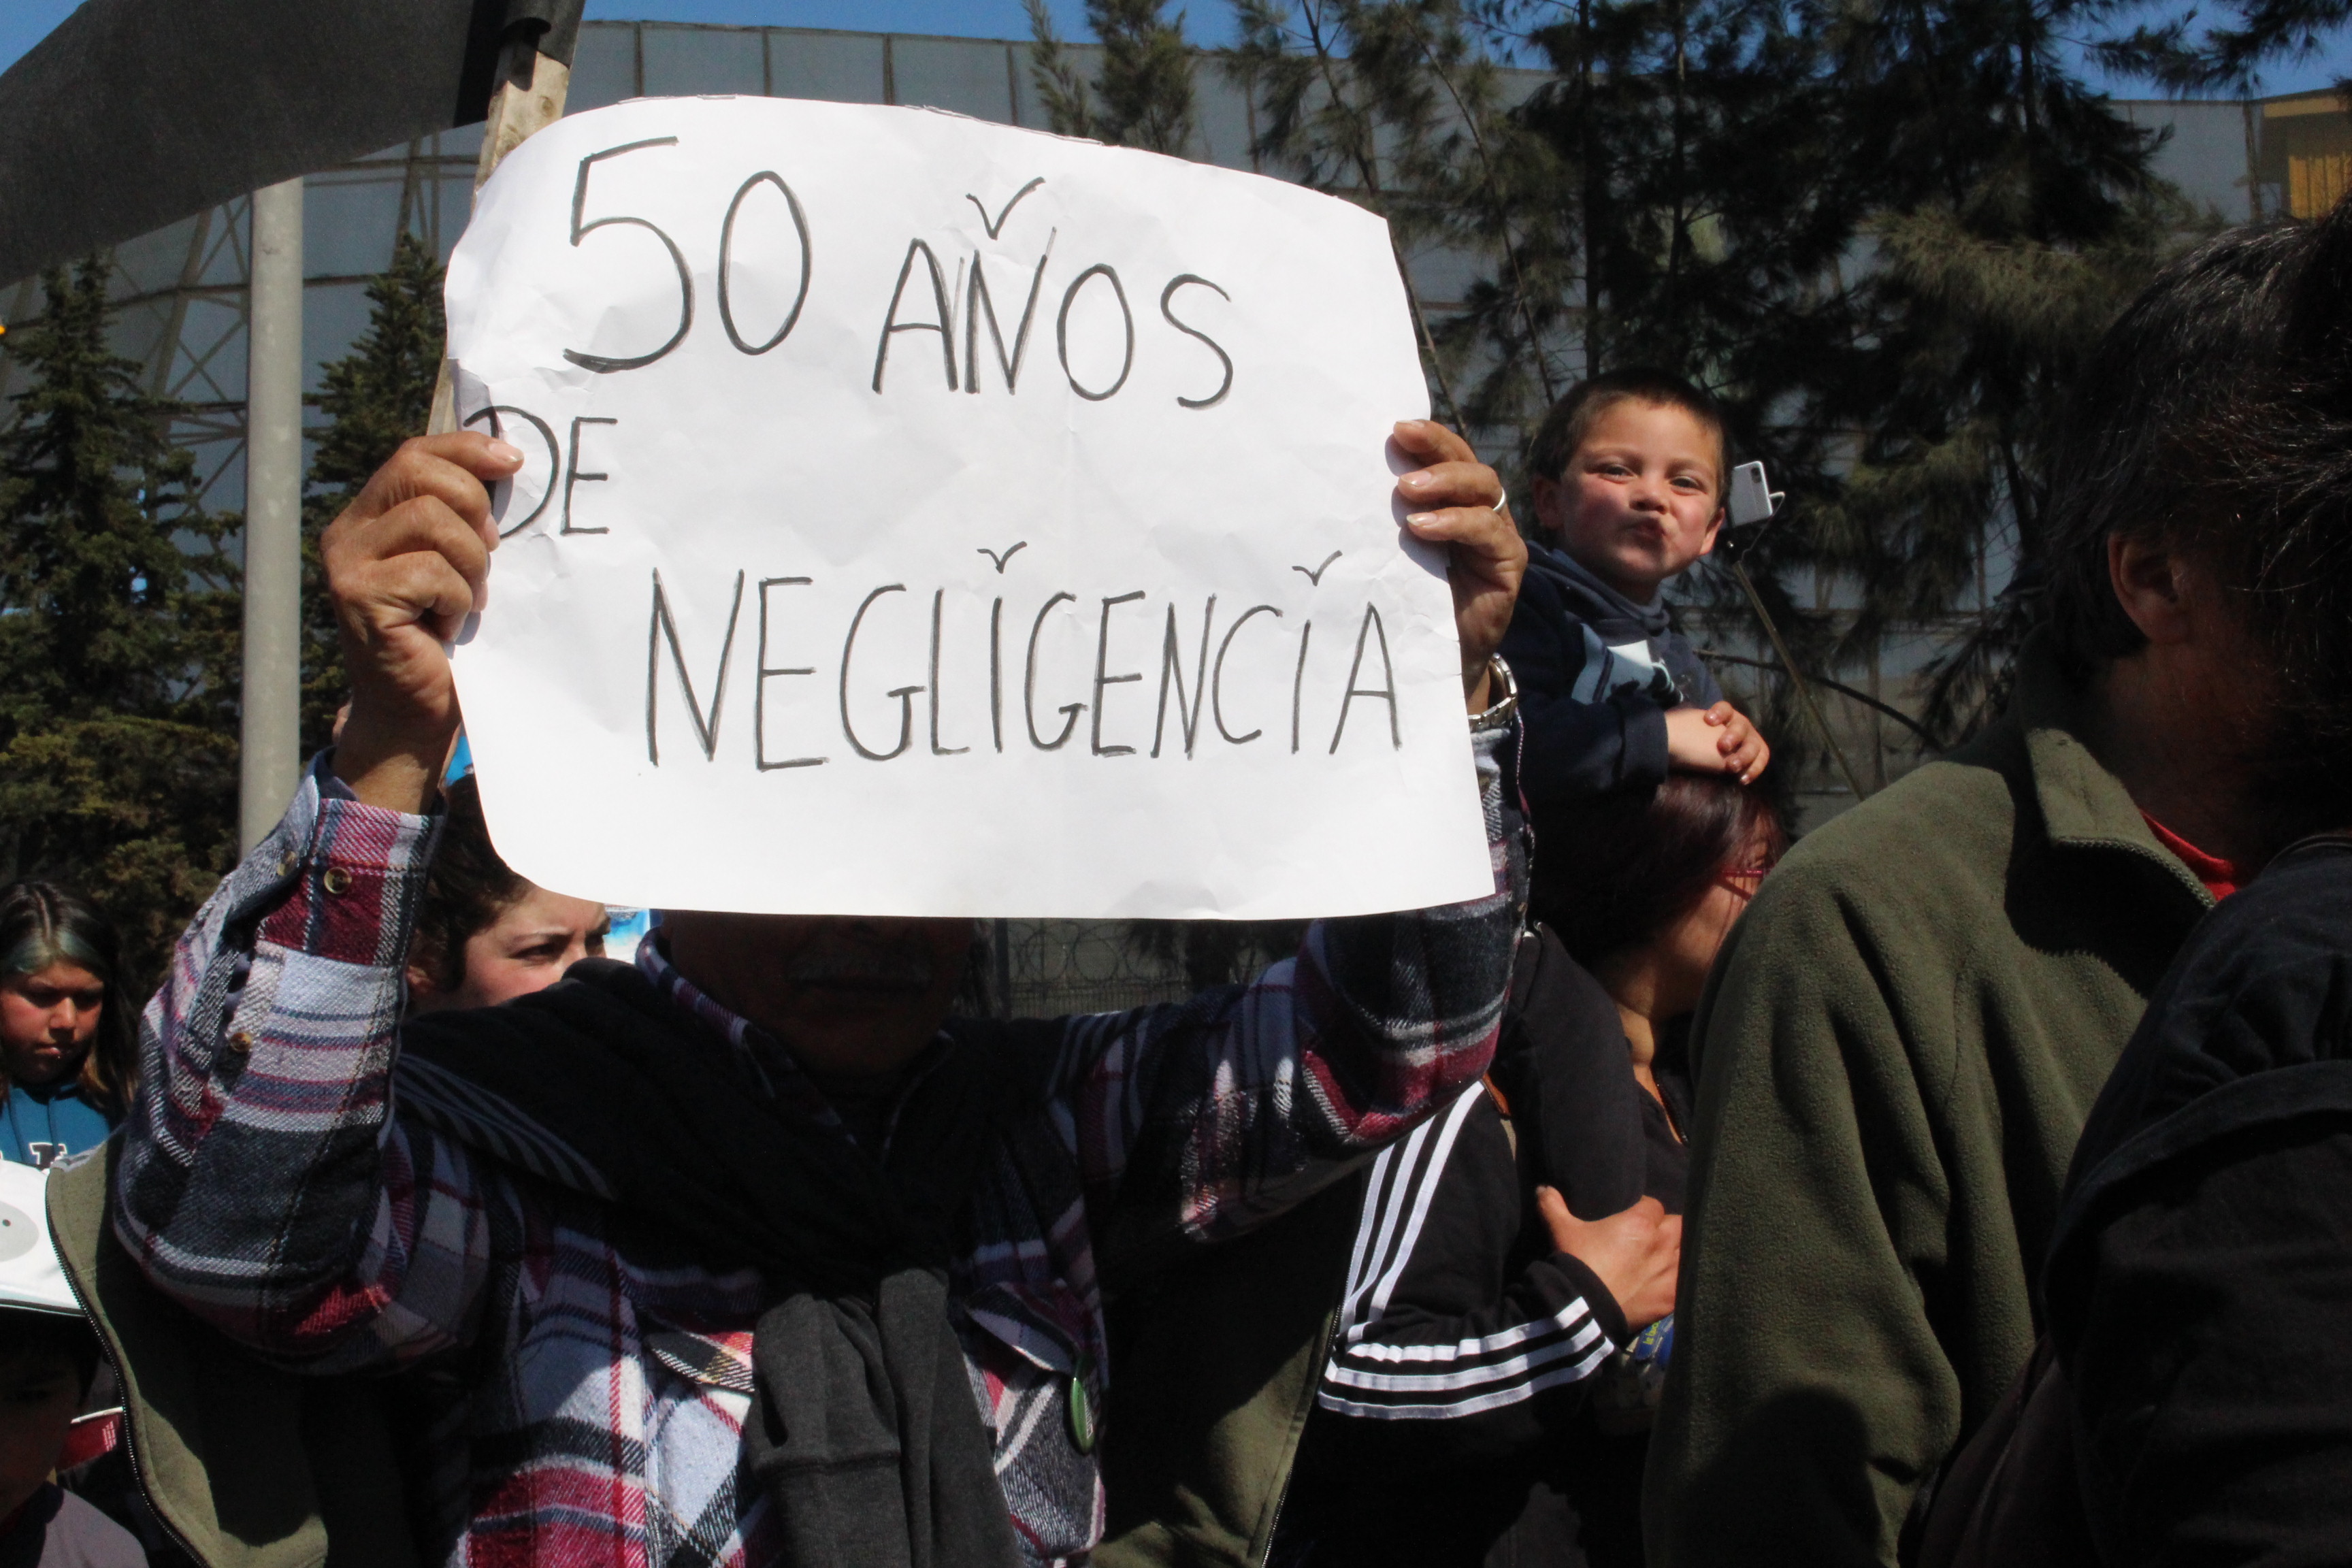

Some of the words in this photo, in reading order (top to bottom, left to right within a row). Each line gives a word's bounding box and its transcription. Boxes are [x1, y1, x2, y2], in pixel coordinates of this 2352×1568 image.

[563, 136, 812, 372] 50
[873, 177, 1235, 409] AÑOS
[463, 405, 619, 540] DE
